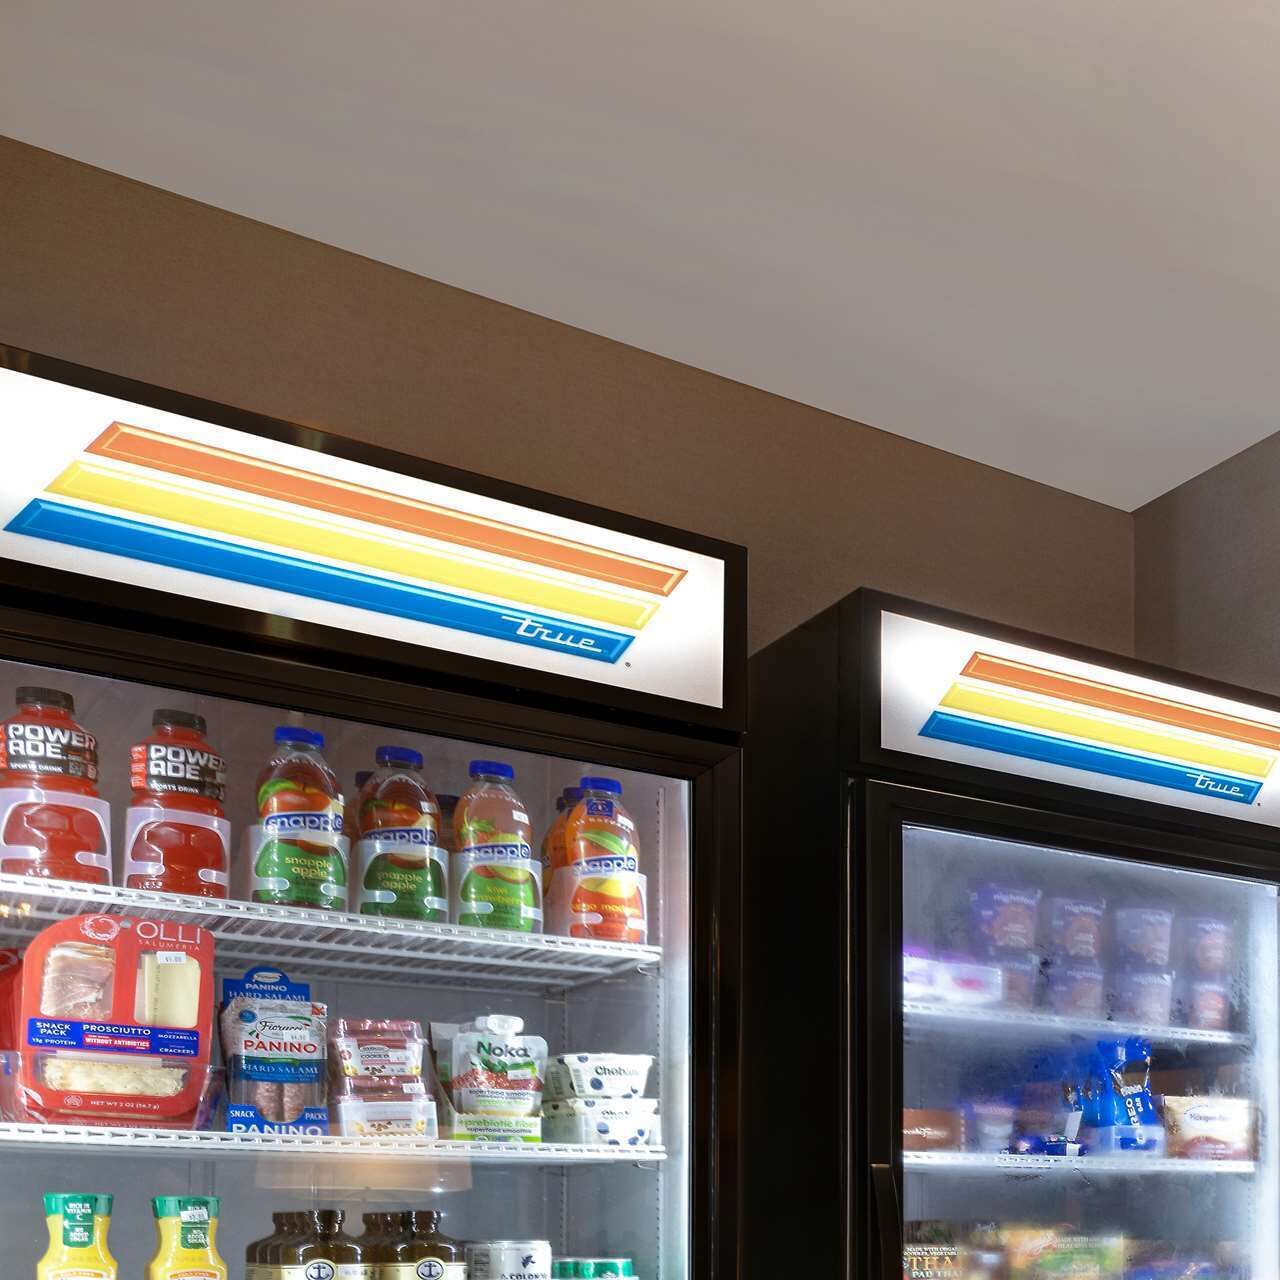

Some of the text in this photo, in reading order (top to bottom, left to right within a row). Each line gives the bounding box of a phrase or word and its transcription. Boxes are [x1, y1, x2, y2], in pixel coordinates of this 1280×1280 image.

[501, 614, 603, 652] true
[8, 724, 96, 750] POWER
[1186, 773, 1244, 796] true
[265, 814, 344, 831] snapple
[135, 921, 201, 945] OLLI
[245, 983, 288, 992] PANINO
[229, 991, 262, 1000] HARD
[36, 1022, 71, 1030] SNACK
[83, 1024, 151, 1036] PROSCIUTTO
[85, 1037, 150, 1048] WITHOUT ANTIBIOTICS
[244, 1039, 317, 1054] PANINO
[159, 1047, 194, 1055] CRACKERS
[477, 1041, 530, 1058] Noka
[243, 1064, 319, 1074] HARD SALAMI
[230, 1110, 255, 1118] SNACK
[232, 1124, 323, 1136] PANINO
